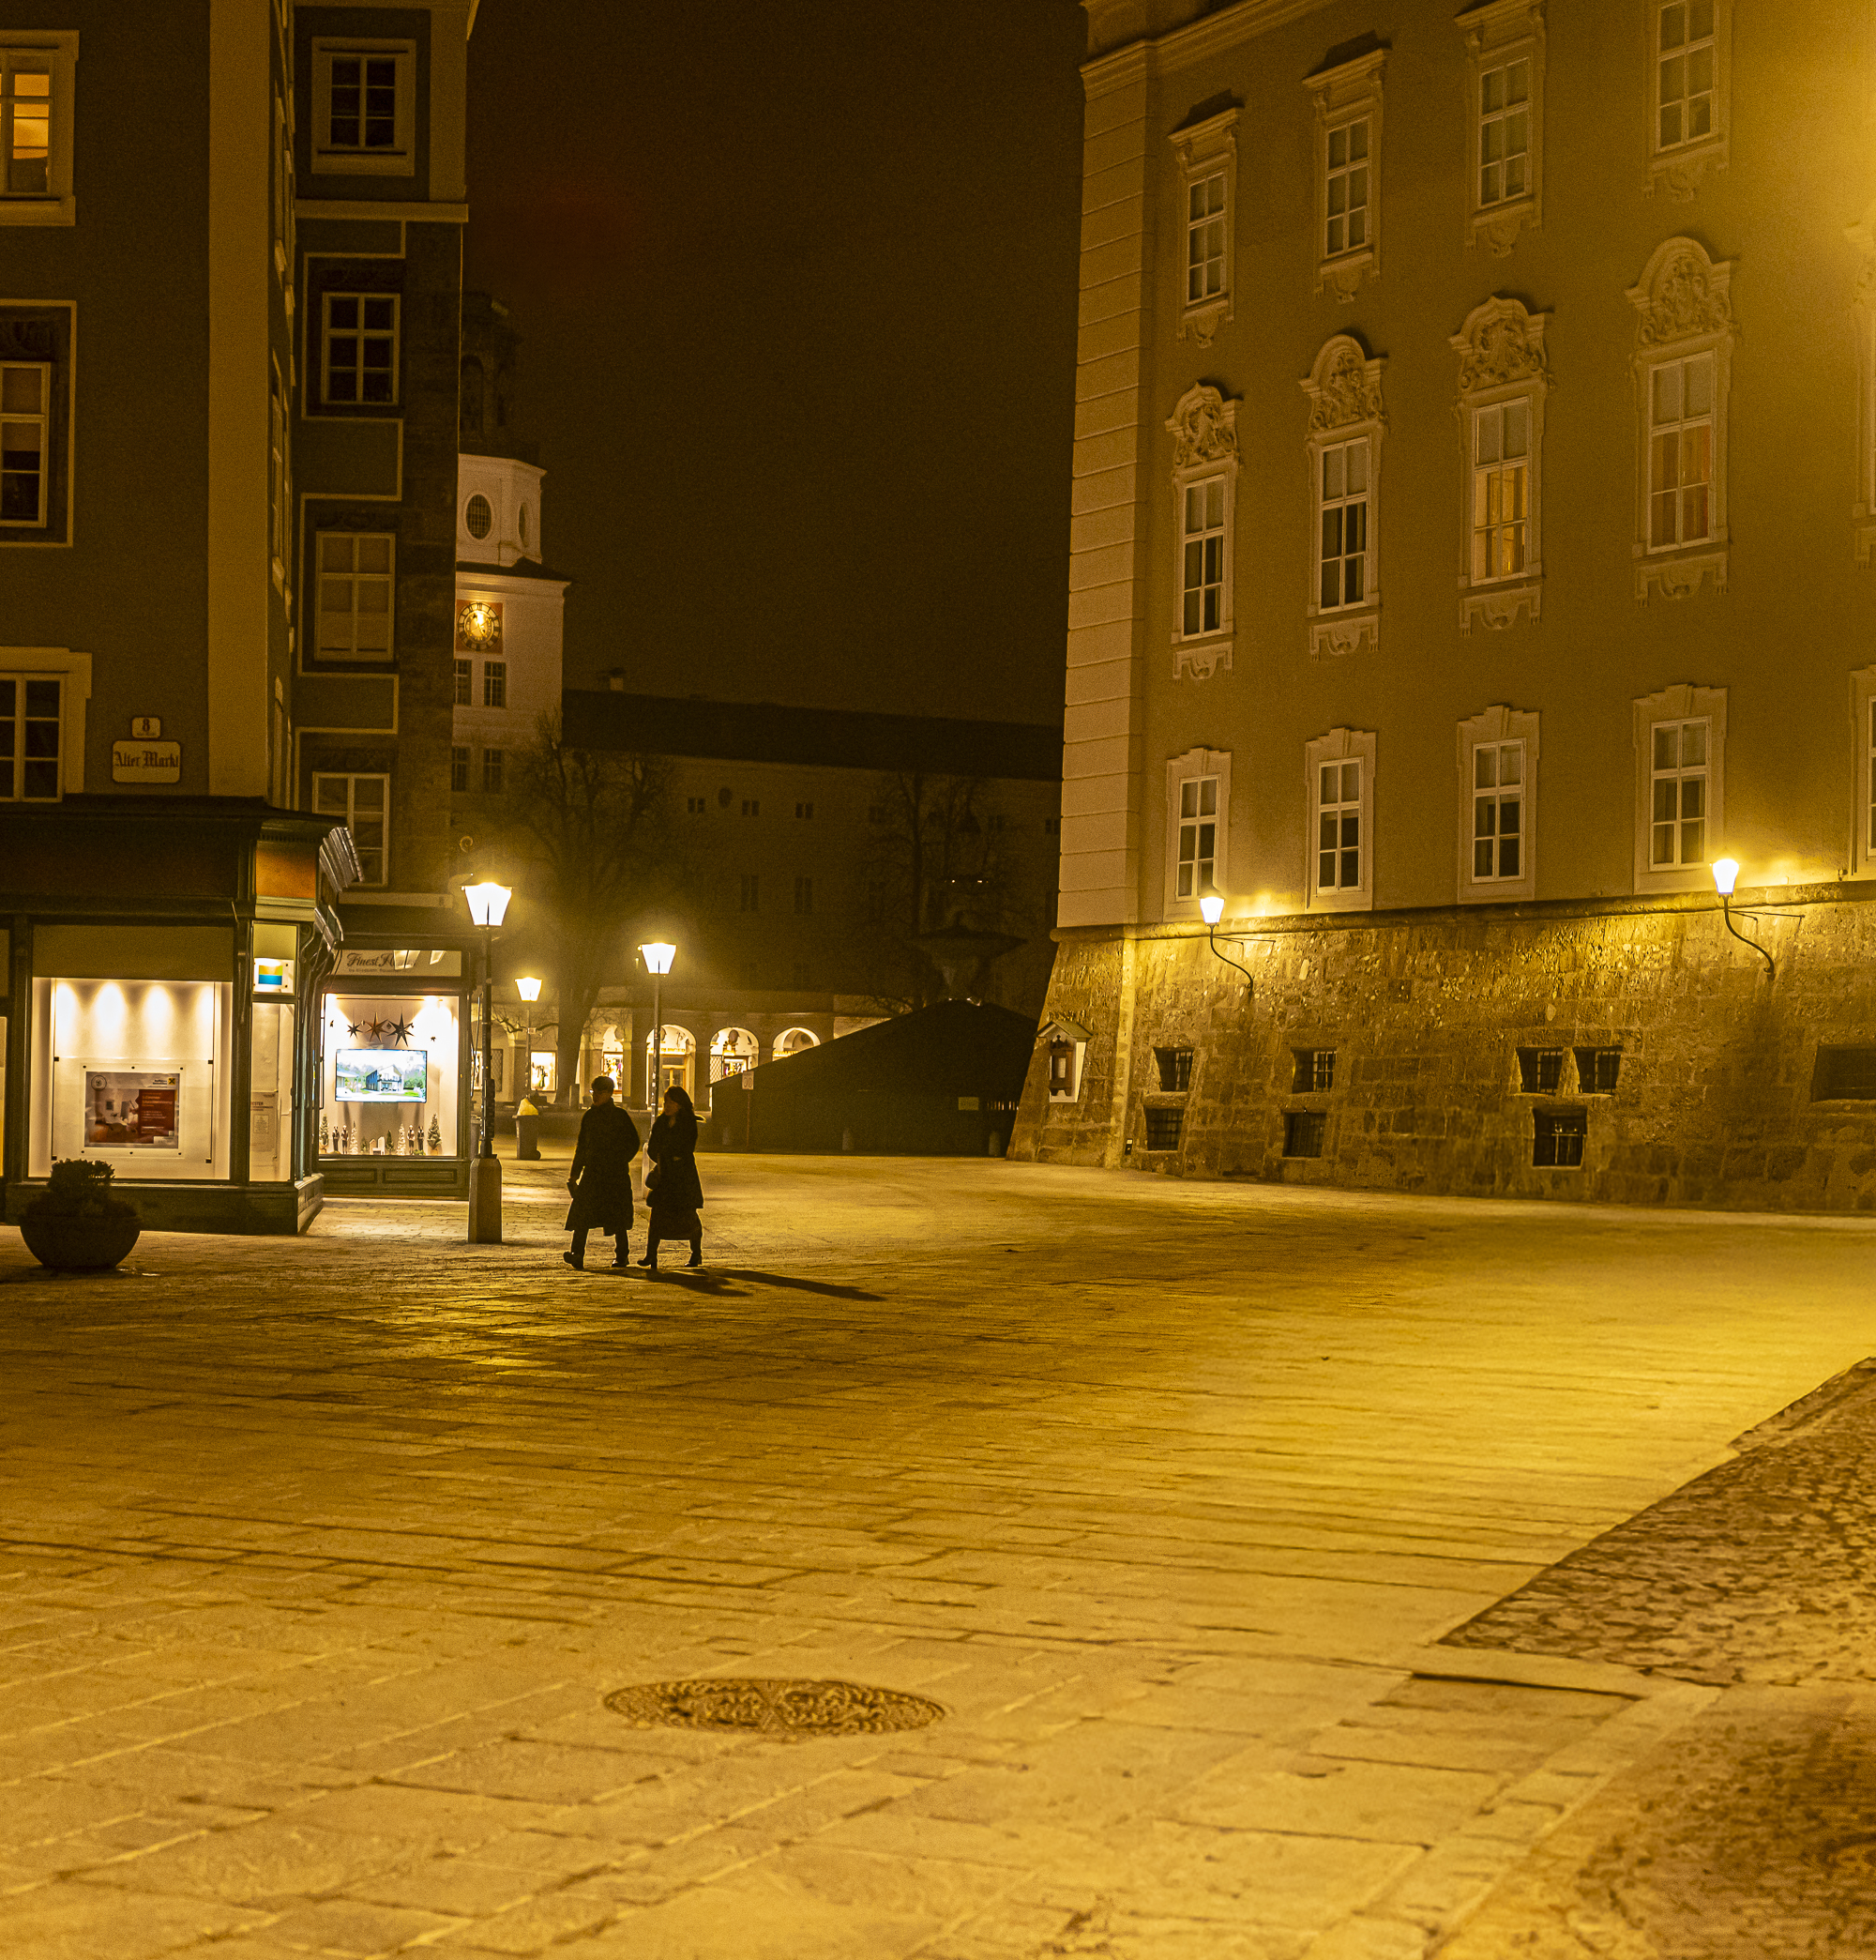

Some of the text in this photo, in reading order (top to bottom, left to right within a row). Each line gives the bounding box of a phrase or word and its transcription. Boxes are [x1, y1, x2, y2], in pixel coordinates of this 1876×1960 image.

[142, 718, 150, 731] 8
[113, 751, 178, 767] Alter Markt
[347, 952, 379, 966] Finest
